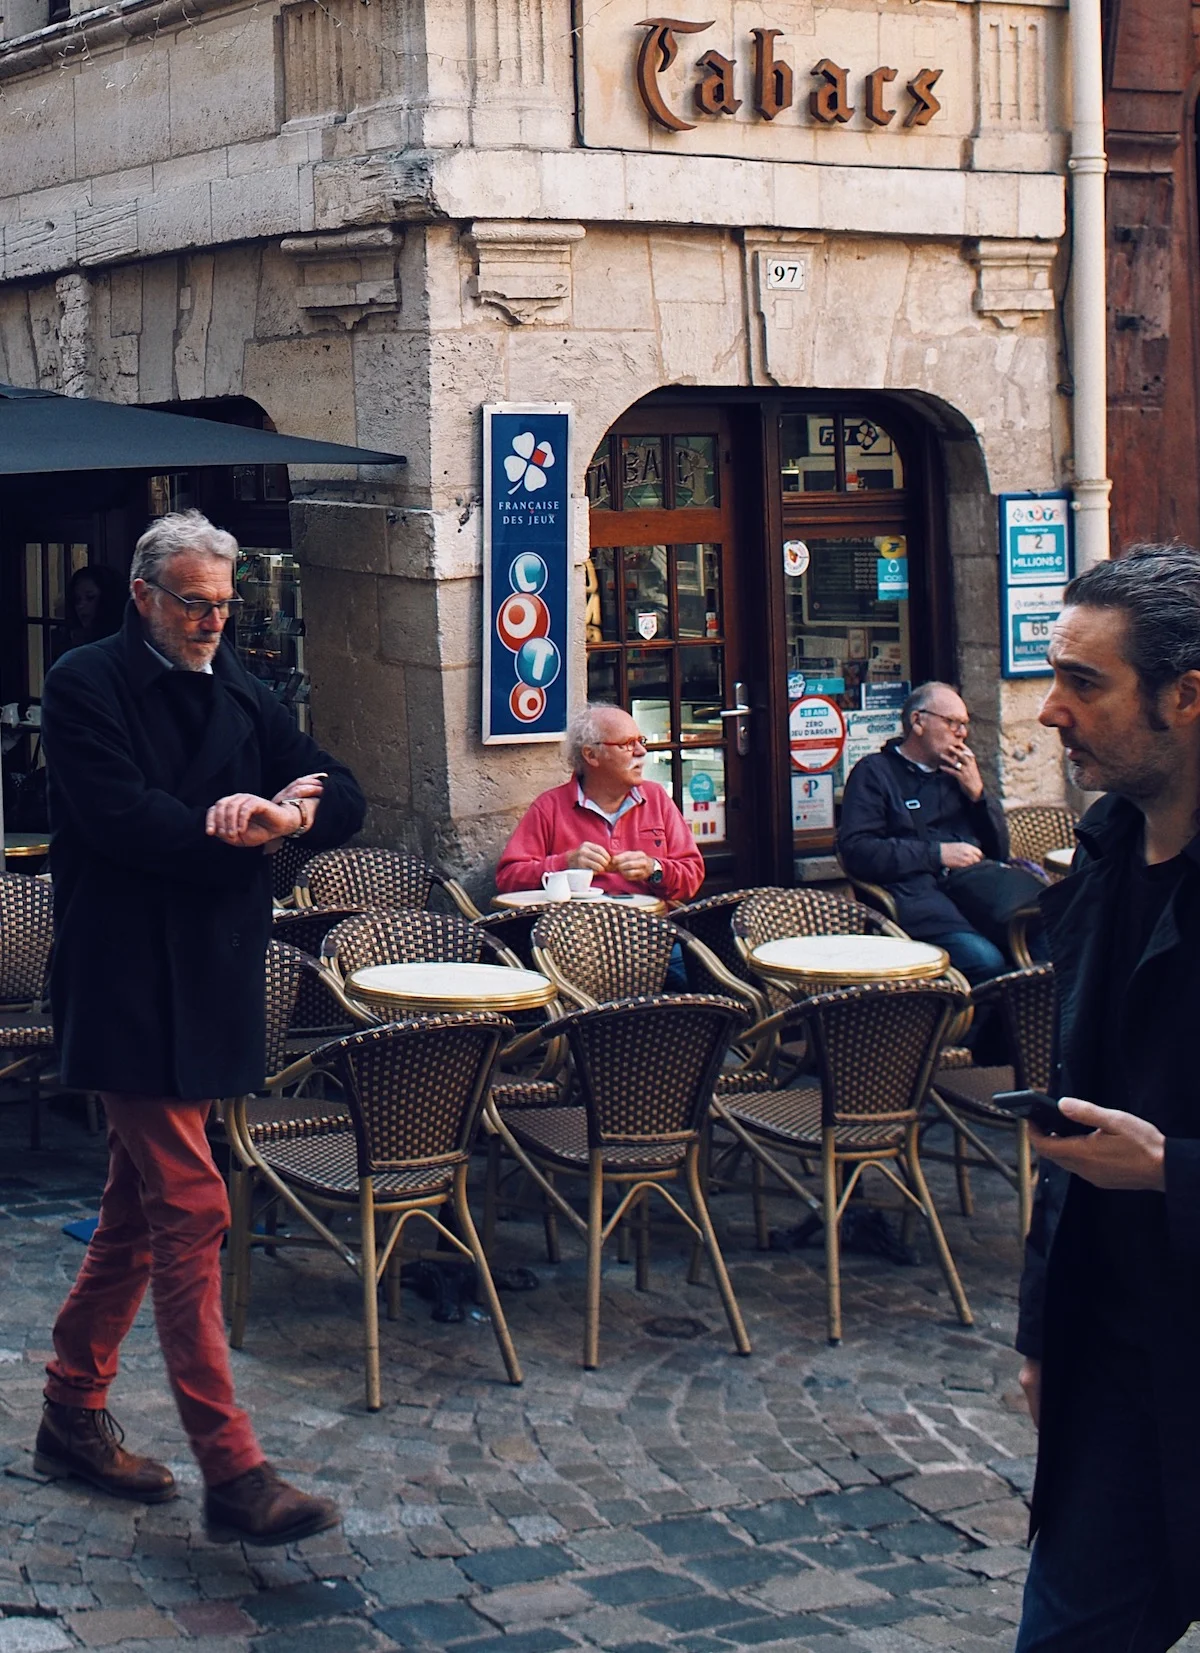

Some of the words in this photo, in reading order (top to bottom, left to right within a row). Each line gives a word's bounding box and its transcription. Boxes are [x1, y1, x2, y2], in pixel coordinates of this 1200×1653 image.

[634, 17, 943, 131] Tabacs
[774, 265, 798, 283] 97
[499, 501, 559, 513] FRANÇAISE
[503, 515, 523, 525] DES
[527, 515, 555, 526] JEUX
[1034, 534, 1043, 549] 2
[1013, 556, 1054, 568] MILLIONS
[1031, 621, 1049, 636] 66
[500, 553, 558, 721] LOTO
[815, 707, 828, 716] ANS
[804, 728, 838, 736] D'ARGENT
